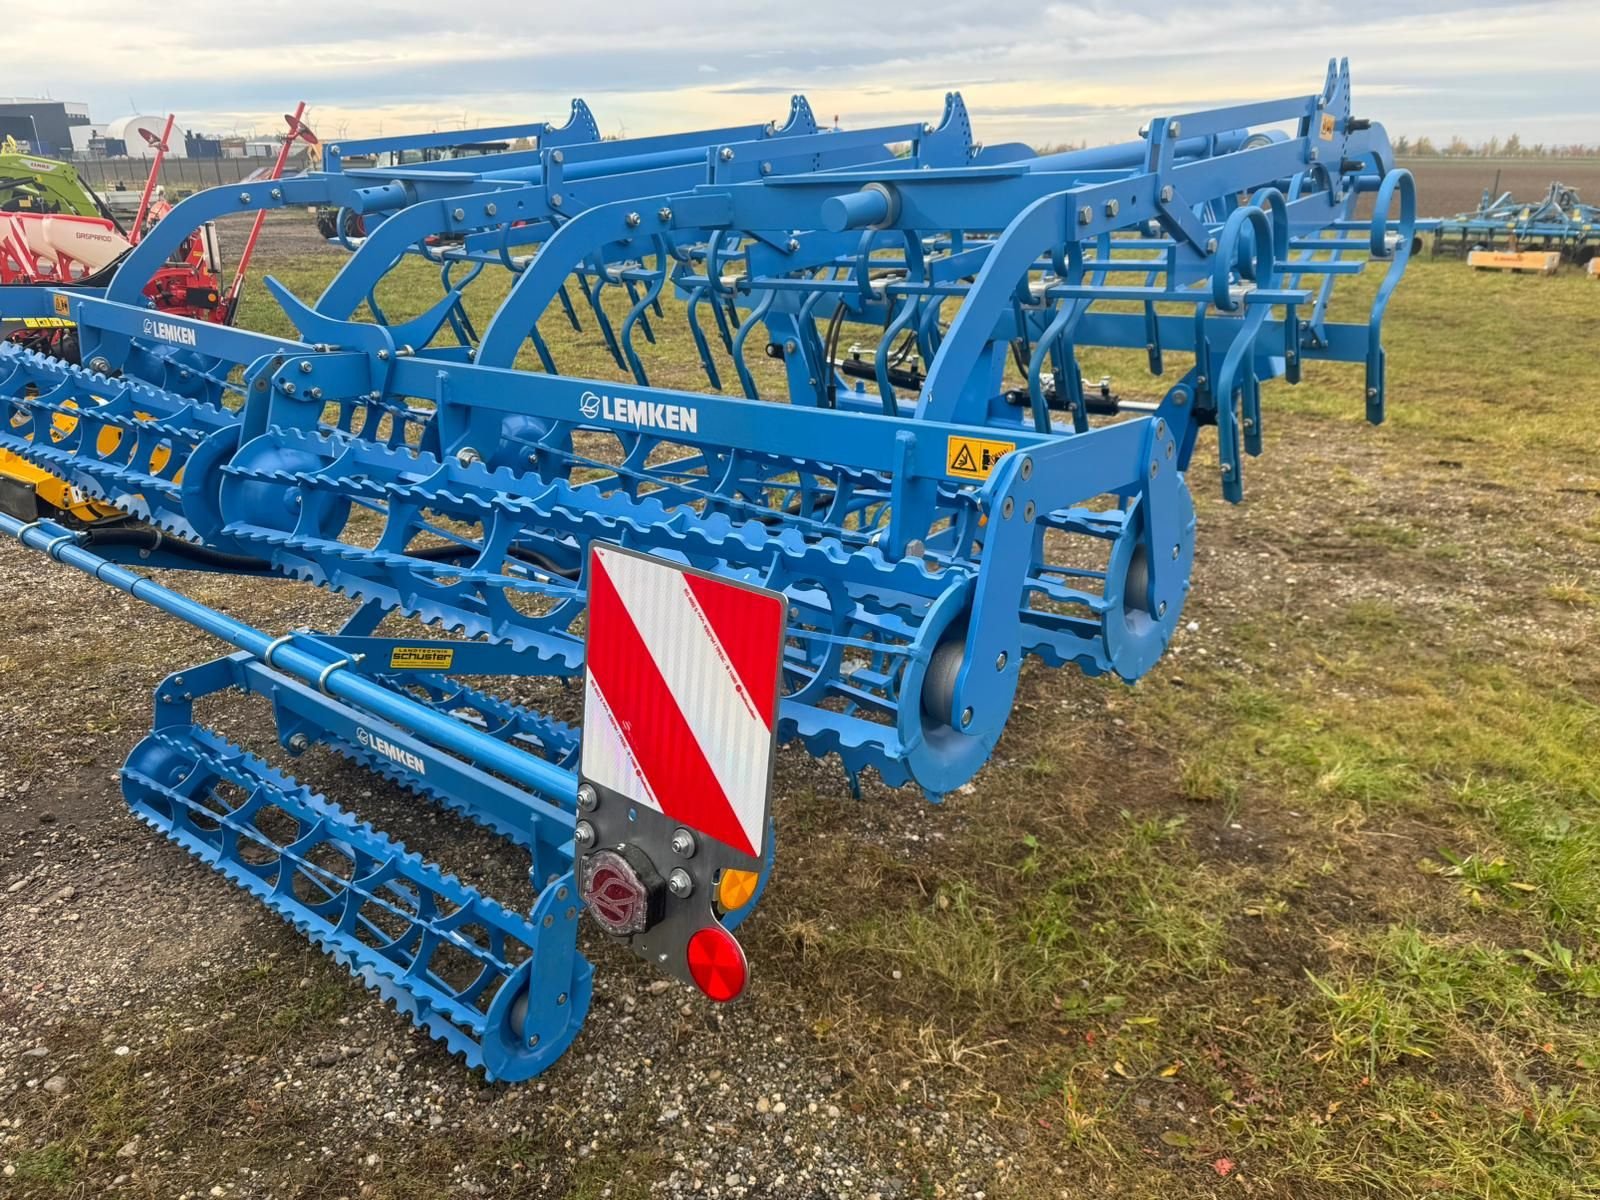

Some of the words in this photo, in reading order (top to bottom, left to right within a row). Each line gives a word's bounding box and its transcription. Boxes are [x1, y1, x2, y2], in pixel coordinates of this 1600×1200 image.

[153, 321, 196, 346] LEMKEN
[602, 396, 697, 433] LEMKEN
[369, 733, 425, 775] LEMKEN
